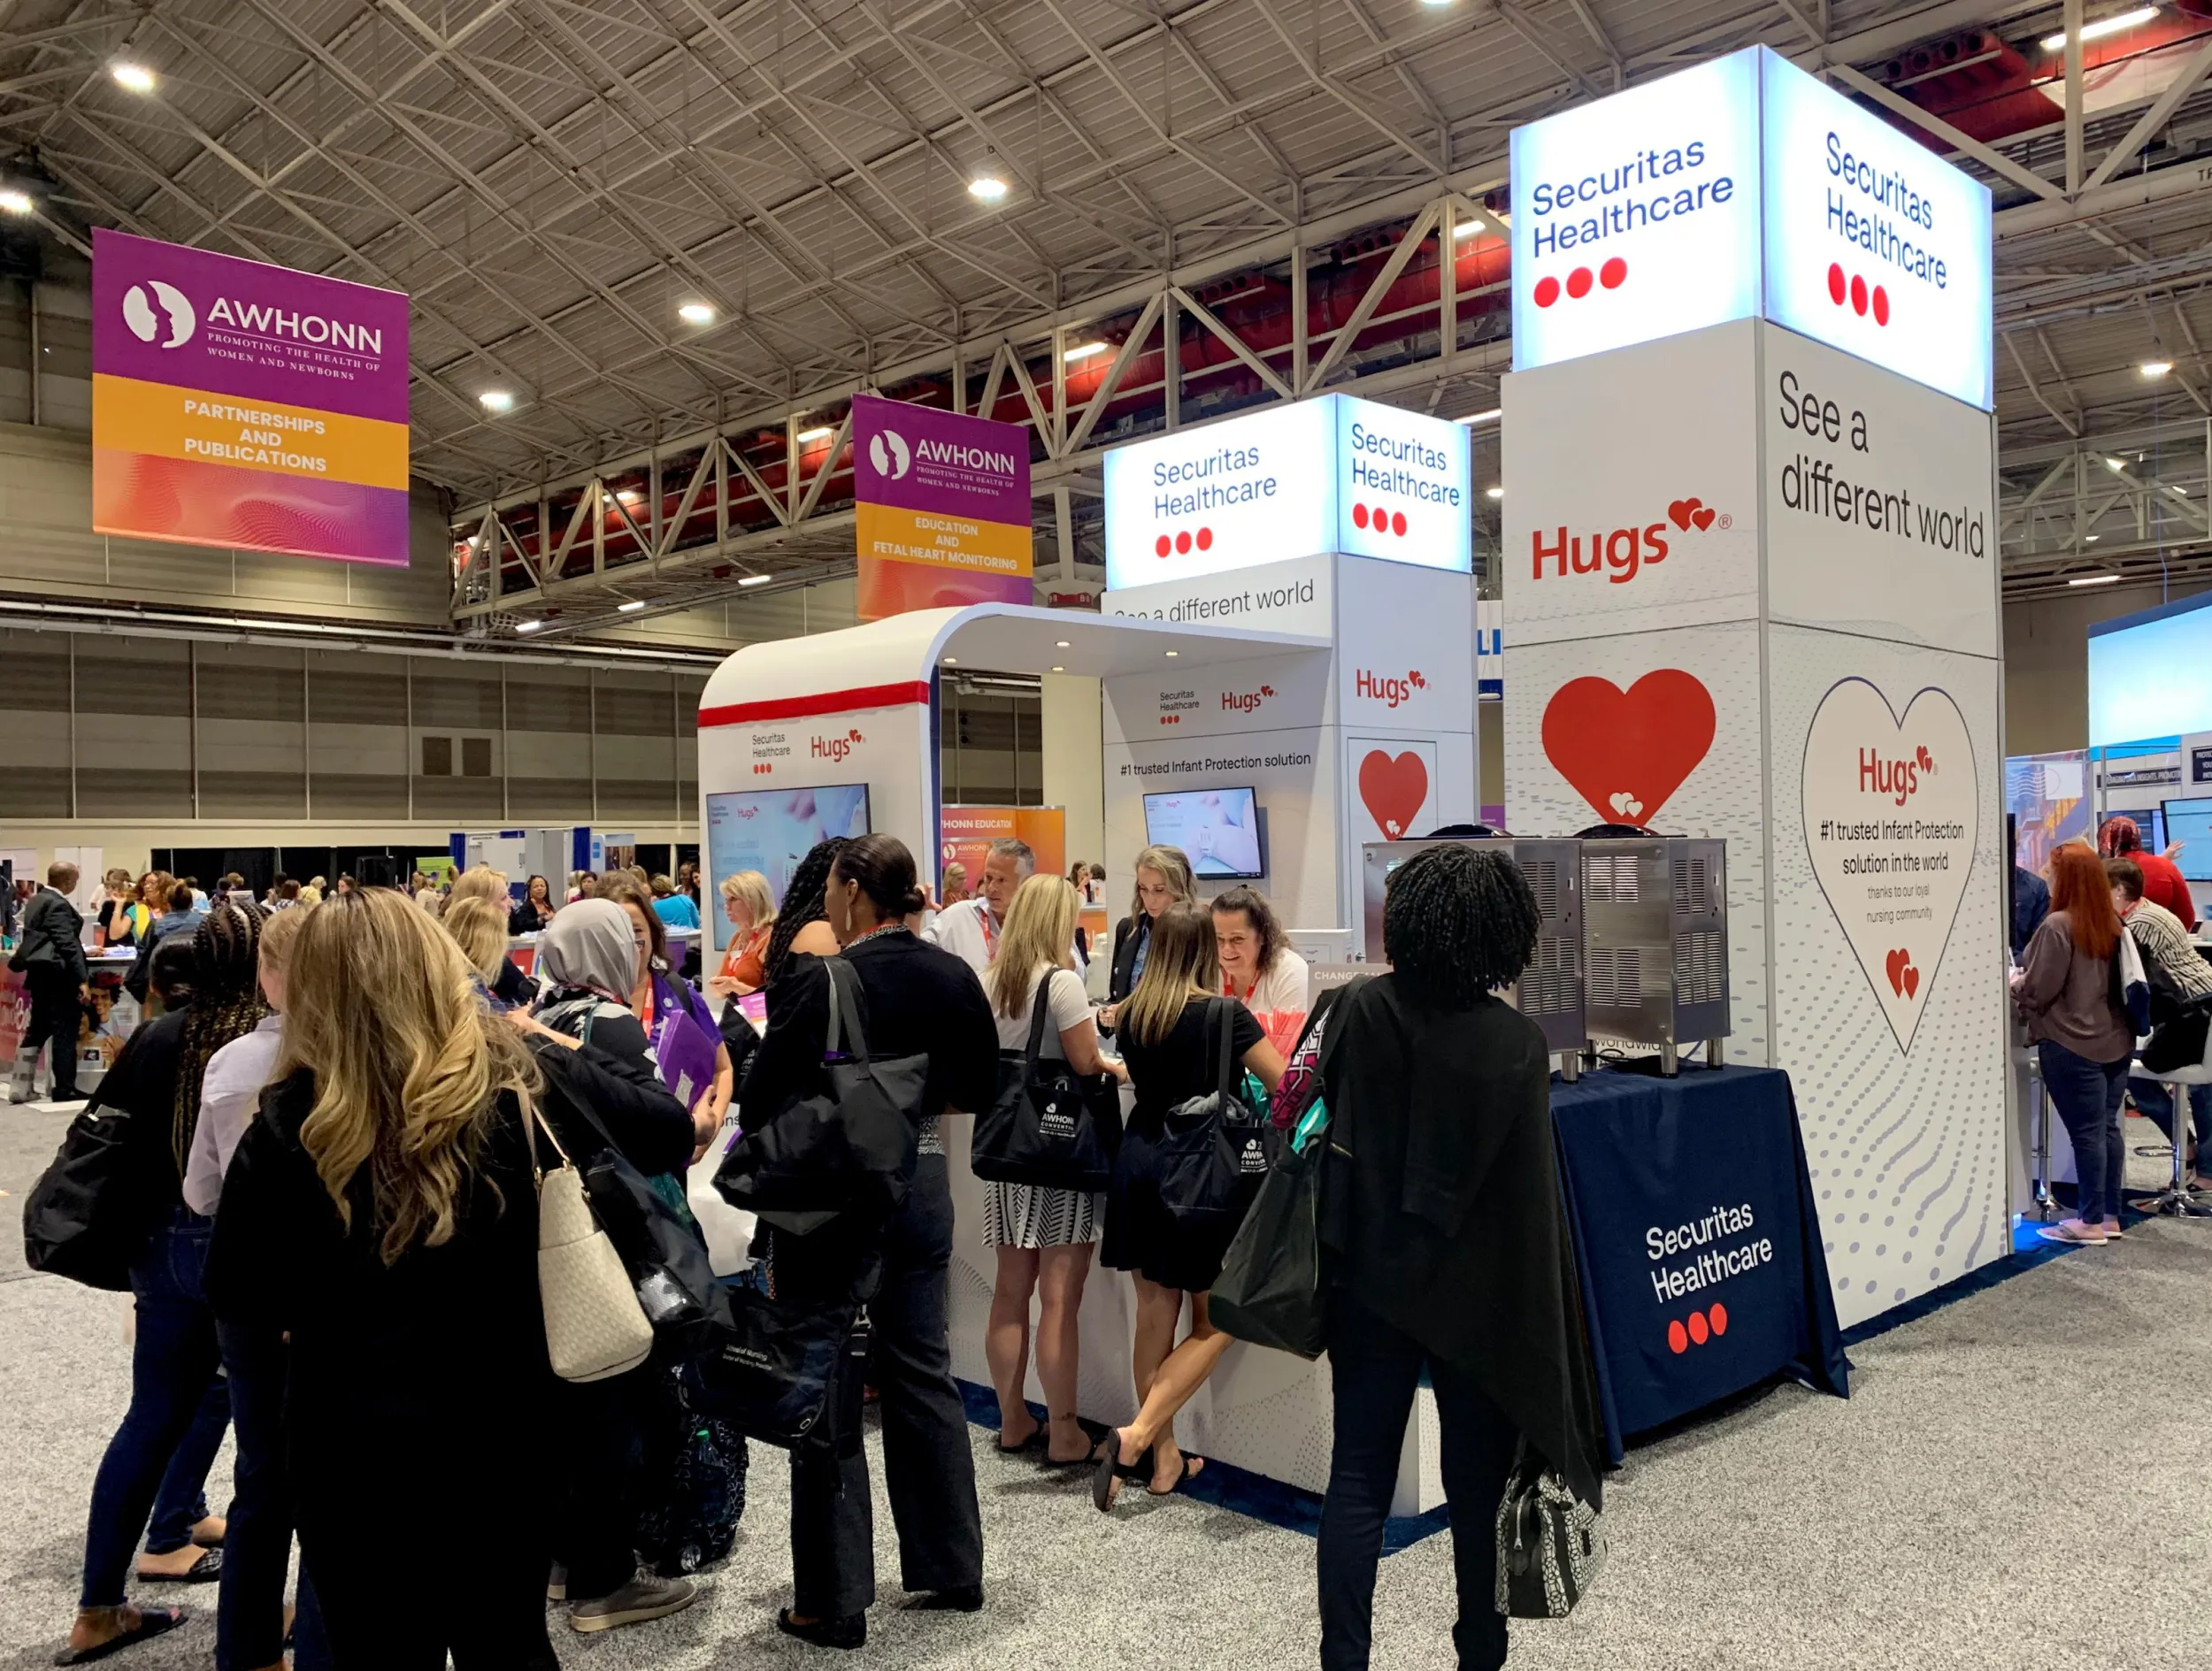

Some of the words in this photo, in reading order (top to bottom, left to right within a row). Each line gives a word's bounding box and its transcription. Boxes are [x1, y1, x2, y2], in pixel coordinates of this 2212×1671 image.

[1532, 141, 1706, 216] Securitas
[1826, 131, 1933, 231] Securitas
[1533, 176, 1734, 258] Healthcare
[1828, 188, 1947, 290] Healthcare
[207, 297, 381, 354] AWHONN
[207, 333, 281, 354] PROMOTING
[286, 348, 310, 358] THE
[314, 353, 361, 368] HEALTH
[365, 362, 380, 372] OF
[207, 347, 254, 363] WOMEN
[259, 357, 285, 369] AND
[290, 361, 355, 381] NEWBORNS
[184, 399, 326, 435] PARTNERSHIPS
[1778, 371, 1840, 443] See
[1851, 410, 1869, 454] a
[185, 439, 326, 471] PUBLICATIONS
[239, 429, 281, 447] AND
[1352, 423, 1447, 471] Securitas
[916, 439, 1015, 475] AWHONN
[917, 465, 957, 479] PROMOTING
[1154, 447, 1260, 487] Securitas
[1155, 475, 1277, 519] Healthcare
[1352, 458, 1461, 508] Healthcare
[1782, 454, 1911, 539] different
[1918, 499, 1985, 559] world
[915, 517, 979, 535] EDUCATION
[935, 535, 959, 547] AND
[873, 541, 908, 556] FETAL
[910, 546, 946, 562] HEART
[948, 551, 1017, 571] MONITORING
[1532, 522, 1669, 584] Hugs
[1170, 591, 1250, 622] different
[1256, 579, 1314, 609] world
[1160, 690, 1194, 701] Securitas
[1160, 701, 1199, 711] Healthcare
[1222, 692, 1261, 713] Hugs
[1356, 669, 1409, 708] Hugs
[752, 732, 785, 745] Securitas
[752, 746, 790, 758] Healthcare
[811, 736, 849, 763] Hugs
[1121, 765, 1132, 776] #1
[1134, 762, 1169, 775] trusted
[1172, 760, 1202, 773] Infant
[1205, 755, 1261, 770] Protection
[1264, 753, 1310, 767] solution
[1859, 747, 1917, 807] Hugs
[737, 808, 754, 819] Hugs
[1821, 820, 1834, 840] #1
[1837, 821, 1879, 840] trusted
[1882, 820, 1913, 839] Infant
[1915, 820, 1964, 839] Protection
[1843, 853, 1888, 874] solution
[1892, 853, 1901, 871] in
[1903, 853, 1920, 871] the
[1923, 851, 1948, 870] world
[1868, 885, 1892, 899] thanks
[1893, 885, 1901, 898] to
[1902, 886, 1914, 897] our
[1915, 884, 1930, 899] loyal
[1867, 910, 1893, 924] nursing
[1896, 906, 1932, 921] community
[1646, 1203, 1754, 1261] Securitas
[1650, 1238, 1773, 1304] Healthcare
